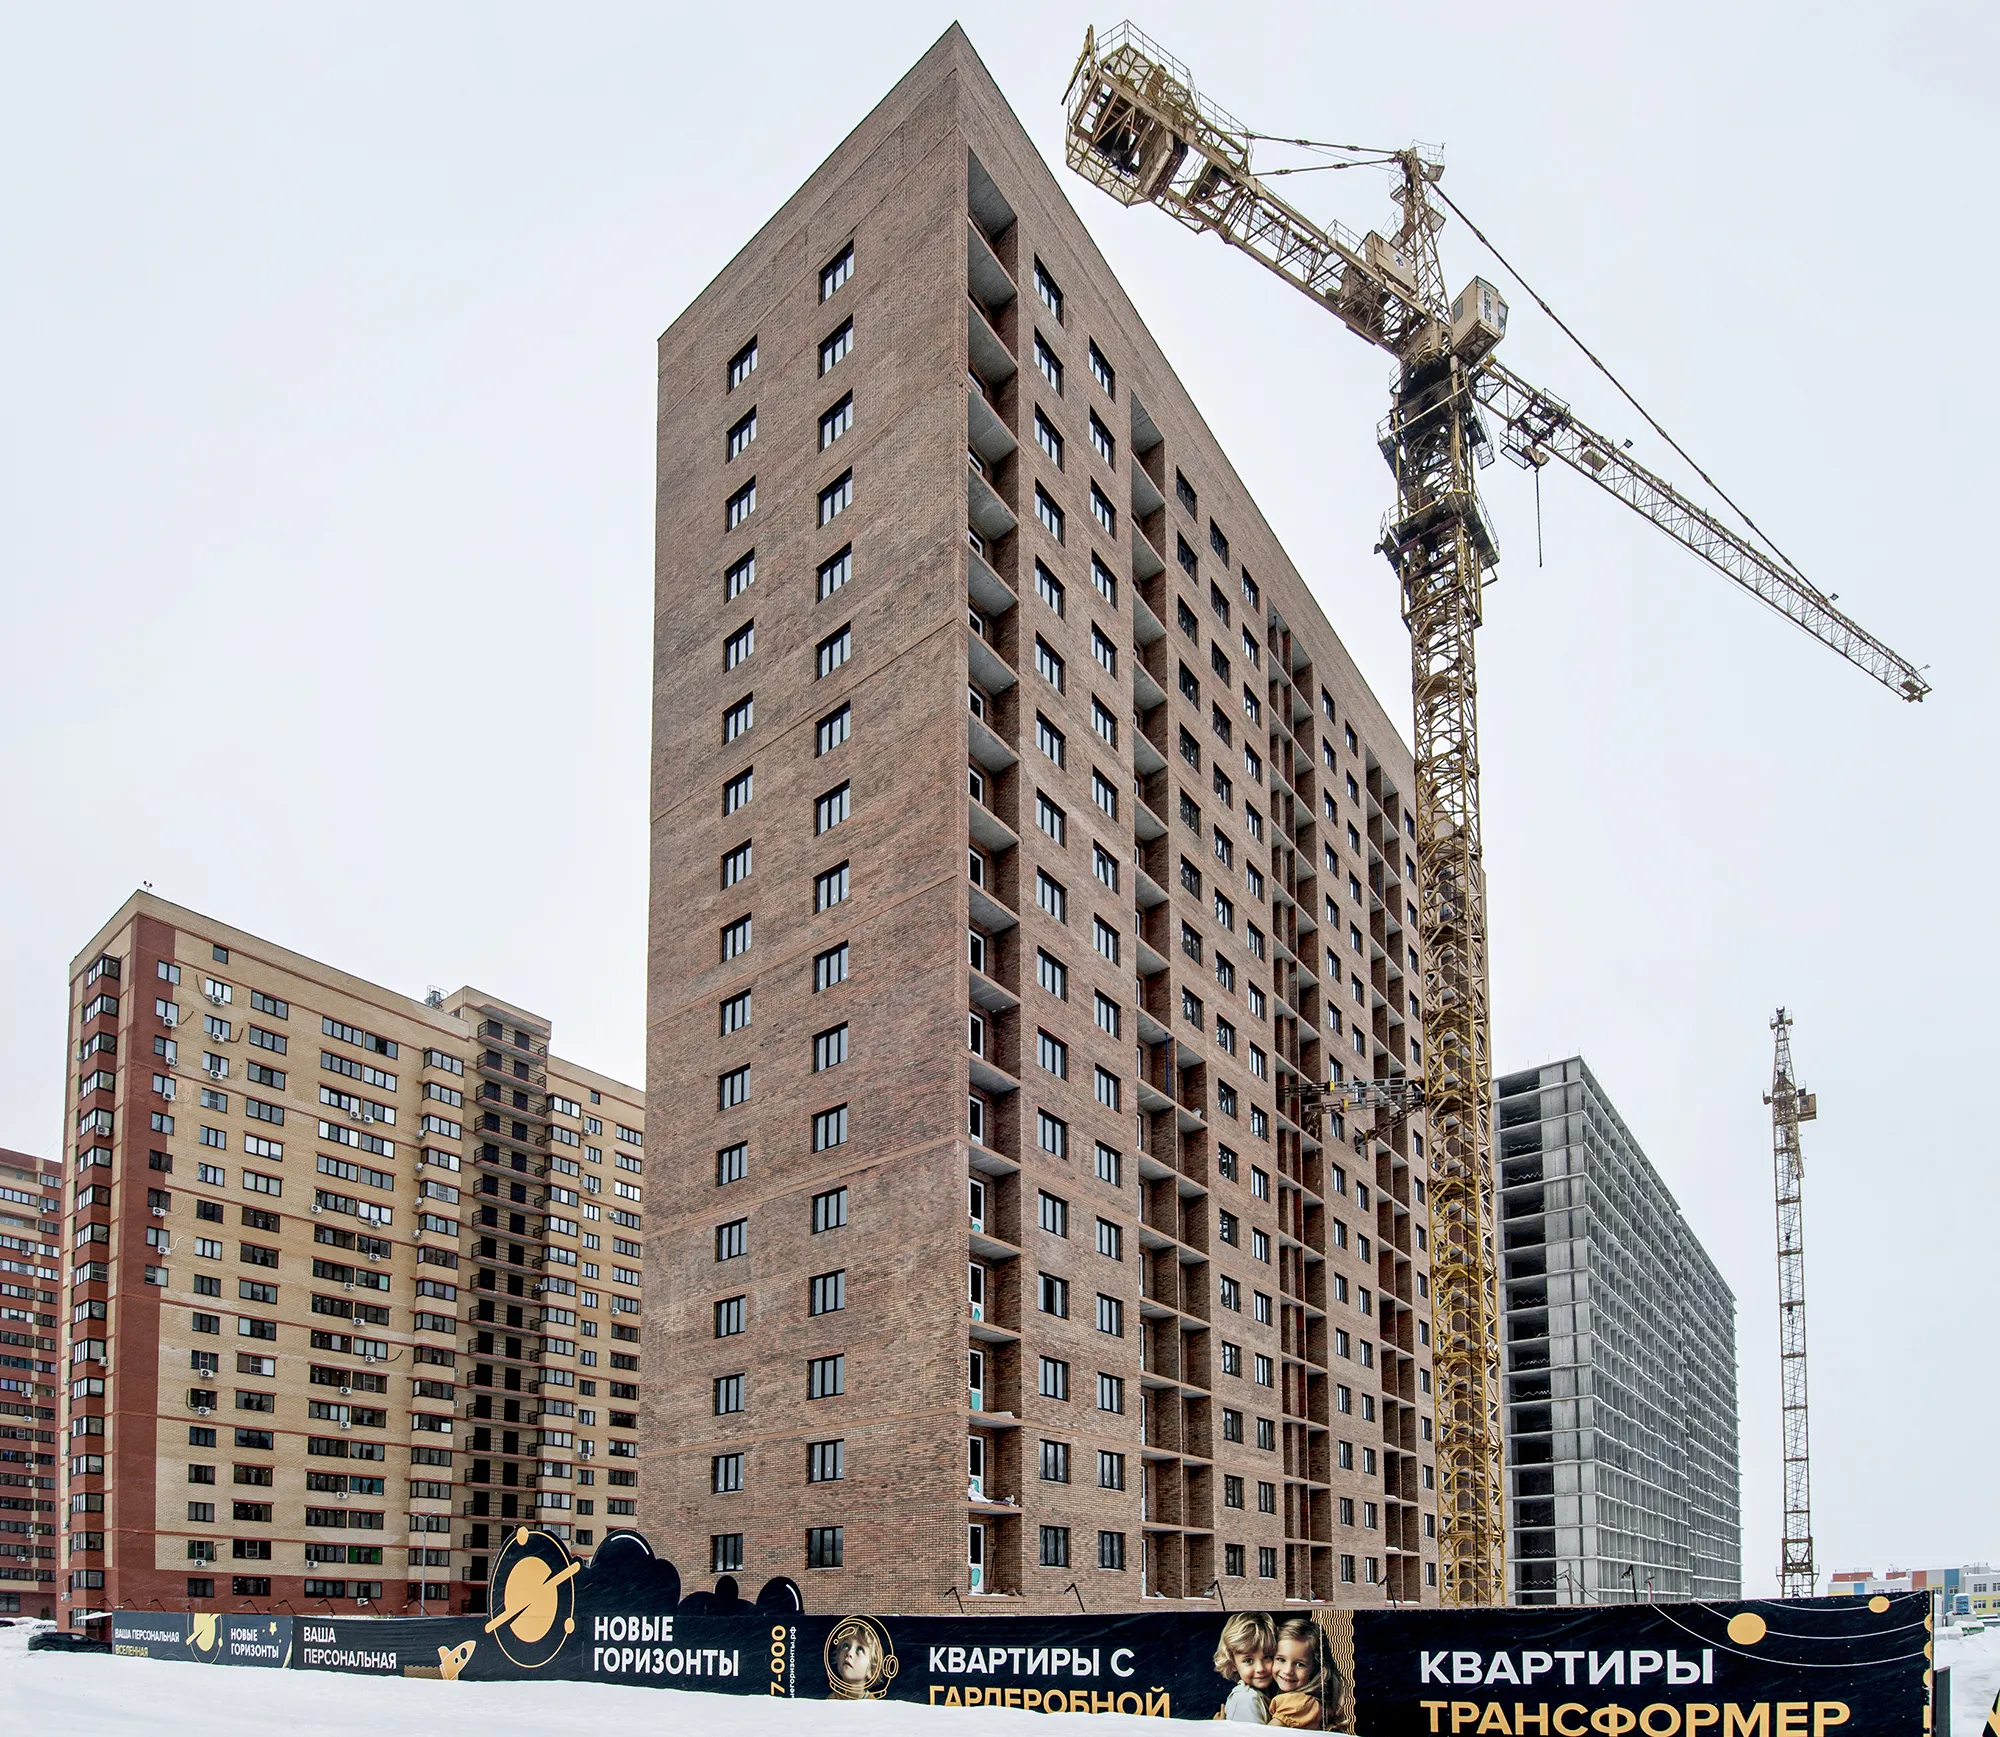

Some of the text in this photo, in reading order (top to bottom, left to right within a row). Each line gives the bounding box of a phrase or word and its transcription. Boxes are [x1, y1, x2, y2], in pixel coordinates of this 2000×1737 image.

[114, 1628, 180, 1643] ВАША ПЕРСОНАЛЬНАЯ
[230, 1628, 258, 1642] НОВЫЕ
[303, 1626, 337, 1643] ВАША
[594, 1615, 674, 1642] НОВЫЕ
[115, 1644, 149, 1657] ВСЕЛЕННАЯ
[230, 1643, 279, 1659] ГОРИЗОНТЫ
[303, 1648, 397, 1670] ПЕРСОНАЛЬНАЯ
[593, 1647, 739, 1677] ГОРИЗОНТЫ
[928, 1646, 1136, 1678] КВАРТИРЫ С
[1419, 1648, 1714, 1685] КВАРТИРЫ
[928, 1684, 1171, 1719] ГАРДЕРОБНОЙ
[1419, 1700, 1851, 1737] ТРАНСФОРМЕР
